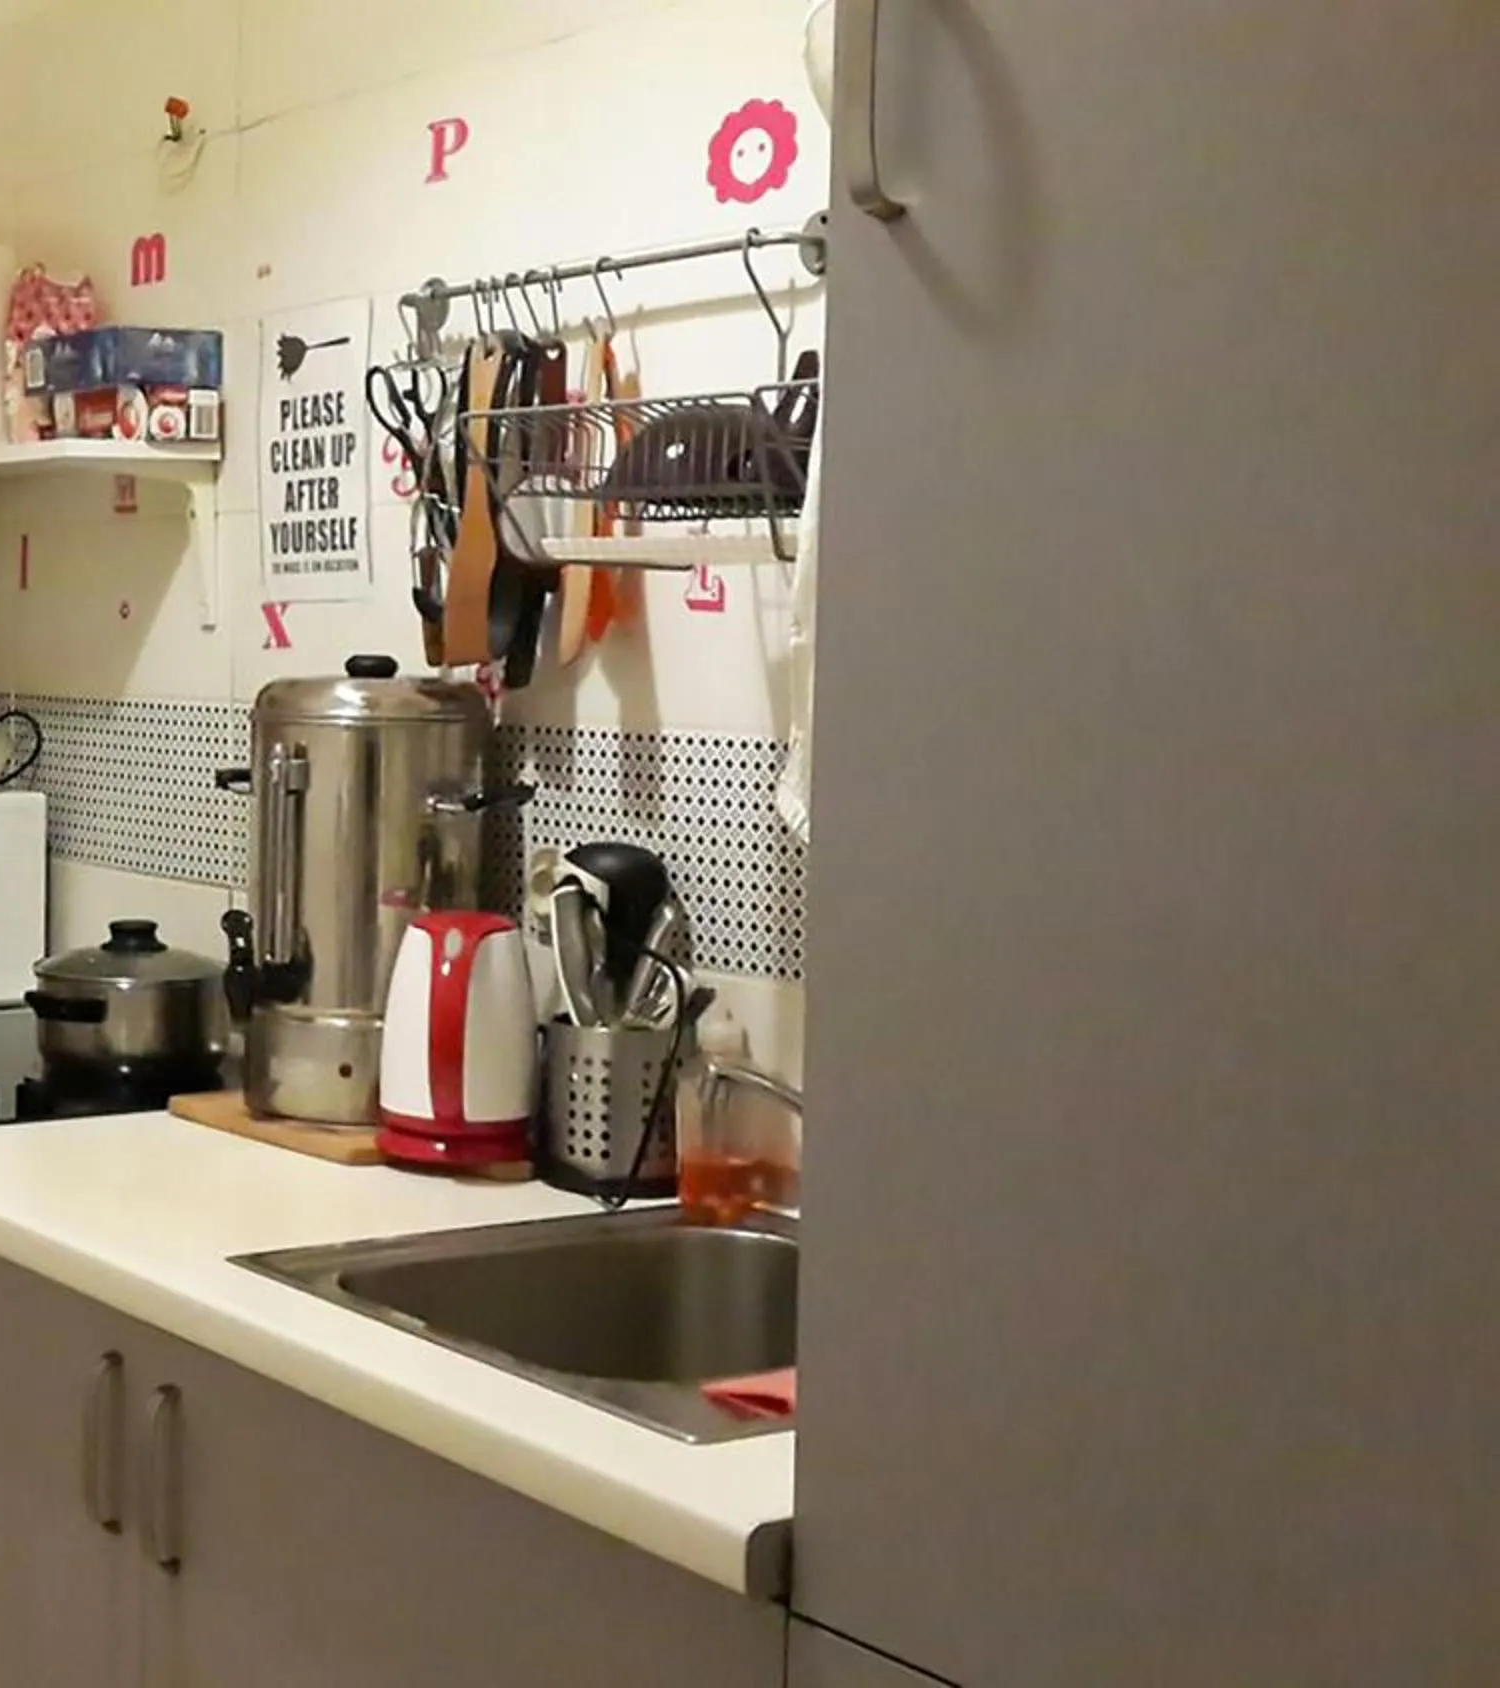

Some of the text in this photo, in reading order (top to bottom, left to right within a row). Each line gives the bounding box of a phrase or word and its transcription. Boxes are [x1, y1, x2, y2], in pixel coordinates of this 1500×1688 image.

[424, 117, 469, 184] P
[280, 391, 345, 432] PLEASE
[270, 436, 326, 474] CLEAN
[331, 432, 357, 468] UP
[284, 476, 340, 513] AFTER
[269, 517, 358, 554] YOURSELF
[260, 601, 292, 650] X
